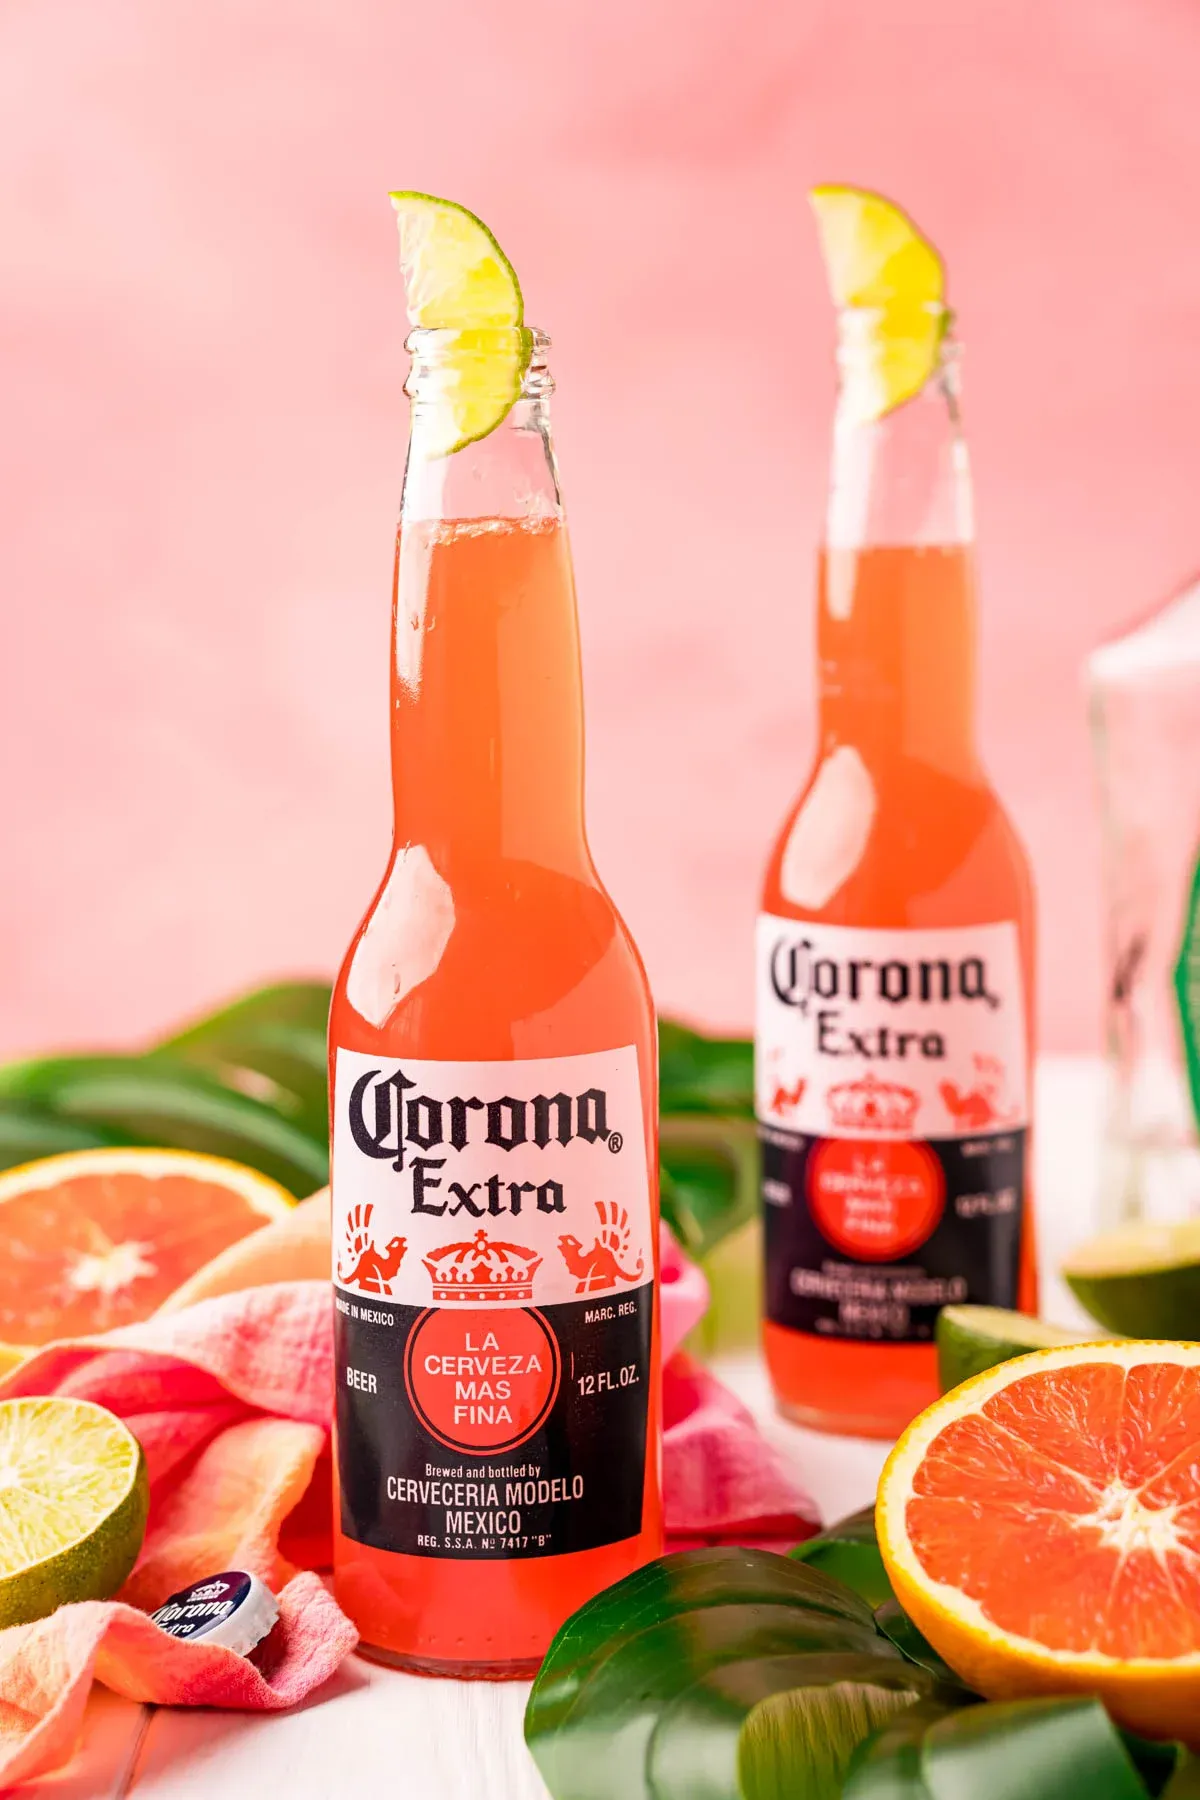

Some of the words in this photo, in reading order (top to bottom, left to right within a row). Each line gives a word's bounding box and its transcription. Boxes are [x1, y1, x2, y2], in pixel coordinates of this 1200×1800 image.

[816, 1010, 946, 1059] Extra
[409, 1156, 567, 1217] Extra
[350, 1304, 359, 1319] IN
[360, 1307, 395, 1327] MEXICO
[584, 1306, 616, 1324] MARC.
[618, 1301, 637, 1317] REG.
[465, 1332, 499, 1351] LA
[424, 1355, 542, 1376] CERVEZA
[346, 1366, 377, 1394] BEER
[455, 1380, 512, 1401] MAS
[577, 1375, 595, 1396] 12
[453, 1405, 513, 1425] FINA
[425, 1463, 463, 1479] Brewed
[466, 1466, 485, 1479] and
[488, 1464, 526, 1479] bottled
[528, 1464, 541, 1479] by
[387, 1476, 500, 1507] CERVECERIA
[505, 1475, 585, 1507] MODELO
[446, 1510, 522, 1535] MEXICO
[417, 1534, 441, 1548] REG.
[444, 1536, 477, 1549] S.S.A.
[500, 1536, 529, 1548] 7417
